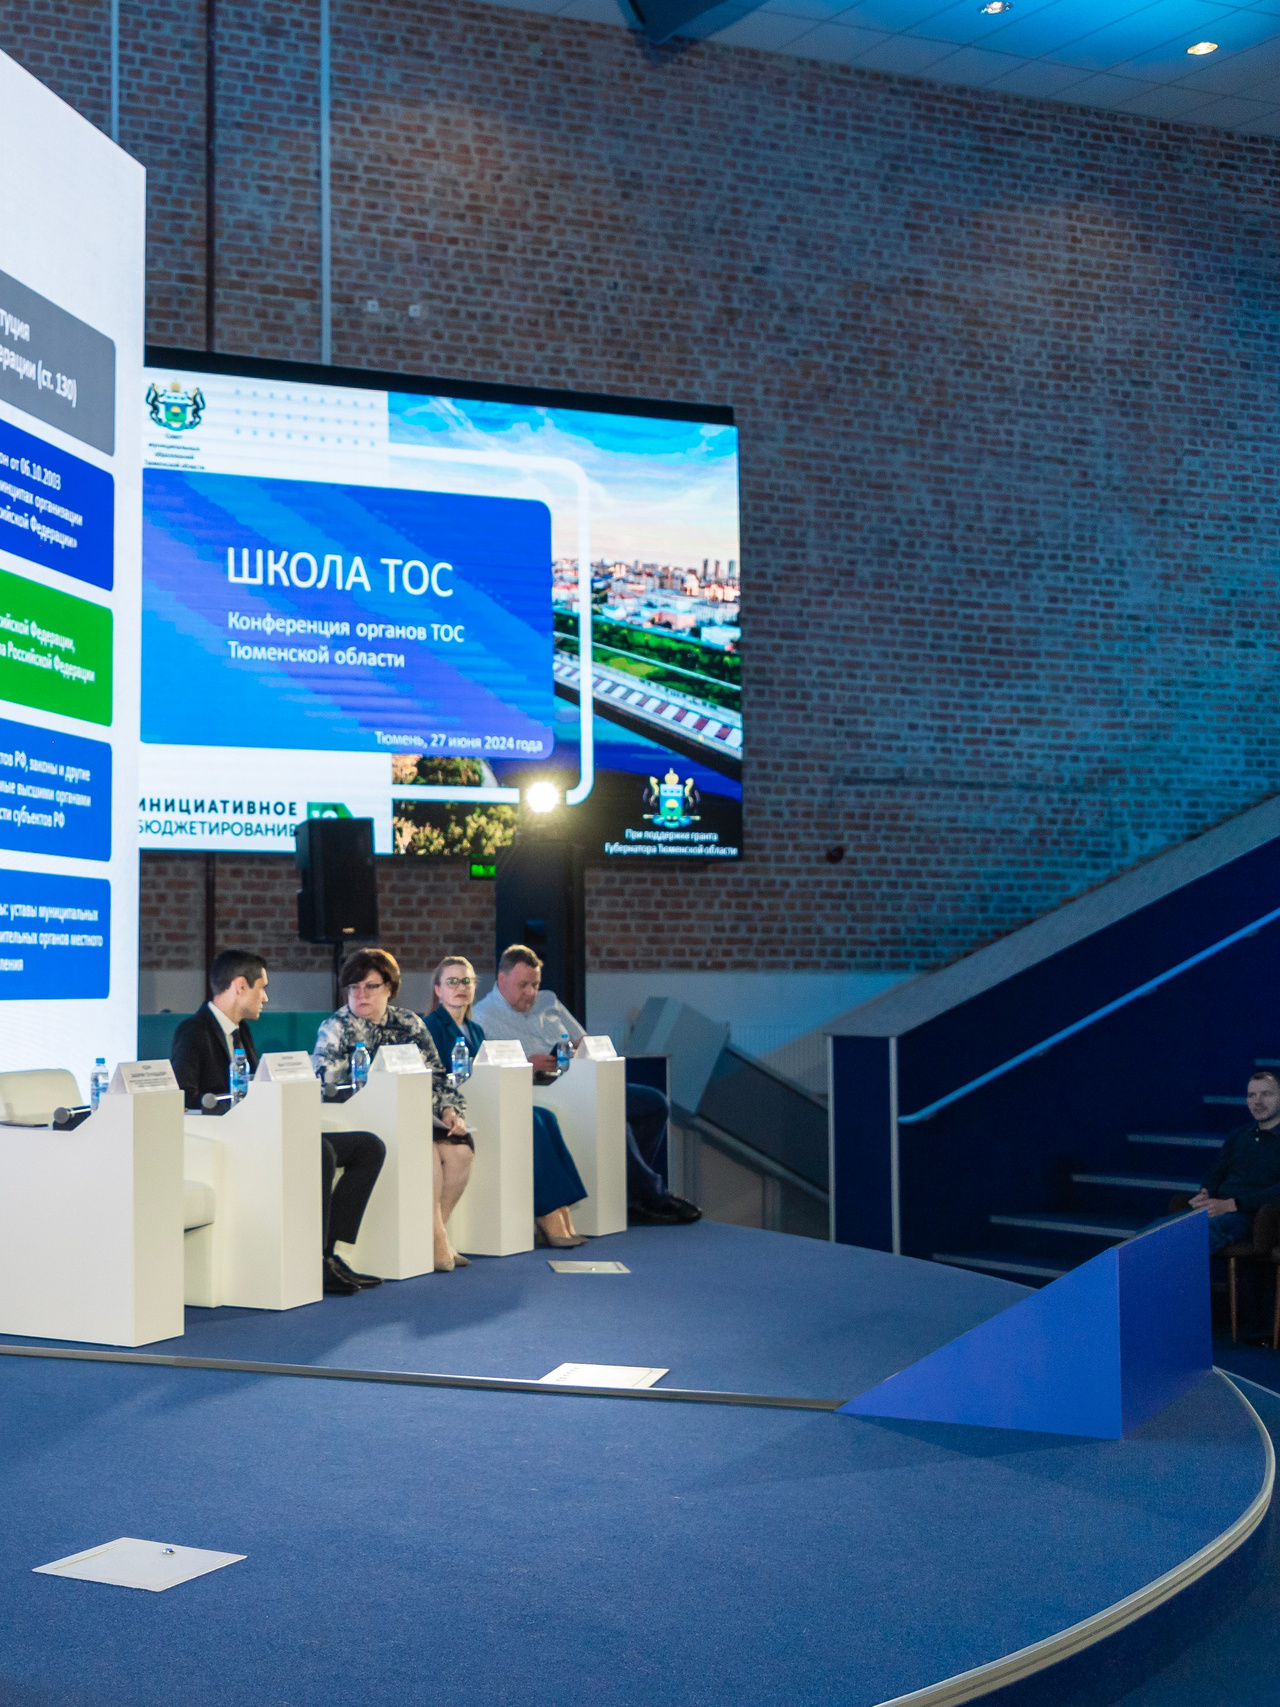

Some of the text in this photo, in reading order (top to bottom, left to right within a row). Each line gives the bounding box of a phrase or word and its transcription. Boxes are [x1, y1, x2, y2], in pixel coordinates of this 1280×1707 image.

[37, 360, 54, 390] (ст.
[55, 372, 78, 408] 130)
[10, 457, 20, 471] от
[20, 457, 62, 491] 06.10.2003
[35, 495, 84, 527] организации
[227, 546, 454, 598] ШКОЛА ТОС
[30, 620, 76, 653] Федерации,
[227, 610, 465, 643] Конференция органов ТОС
[7, 640, 53, 670] Российской
[53, 653, 96, 684] Федерации
[227, 639, 406, 669] Тюменской области
[375, 730, 544, 754] Тюмень, 27 июня 2024 года
[14, 750, 29, 773] РФ,
[29, 757, 58, 776] законы
[59, 763, 65, 777] и
[65, 764, 91, 784] другие
[17, 782, 54, 801] высшими
[55, 788, 91, 808] органами
[13, 805, 53, 829] субъектов
[53, 809, 65, 829] РФ
[604, 842, 738, 857] Губернатора Тюменской области
[625, 828, 719, 843] При поддержке гранта
[10, 903, 38, 921] уставы
[38, 906, 99, 924] муниципальных
[39, 932, 70, 949] органов
[70, 932, 103, 948] местного
